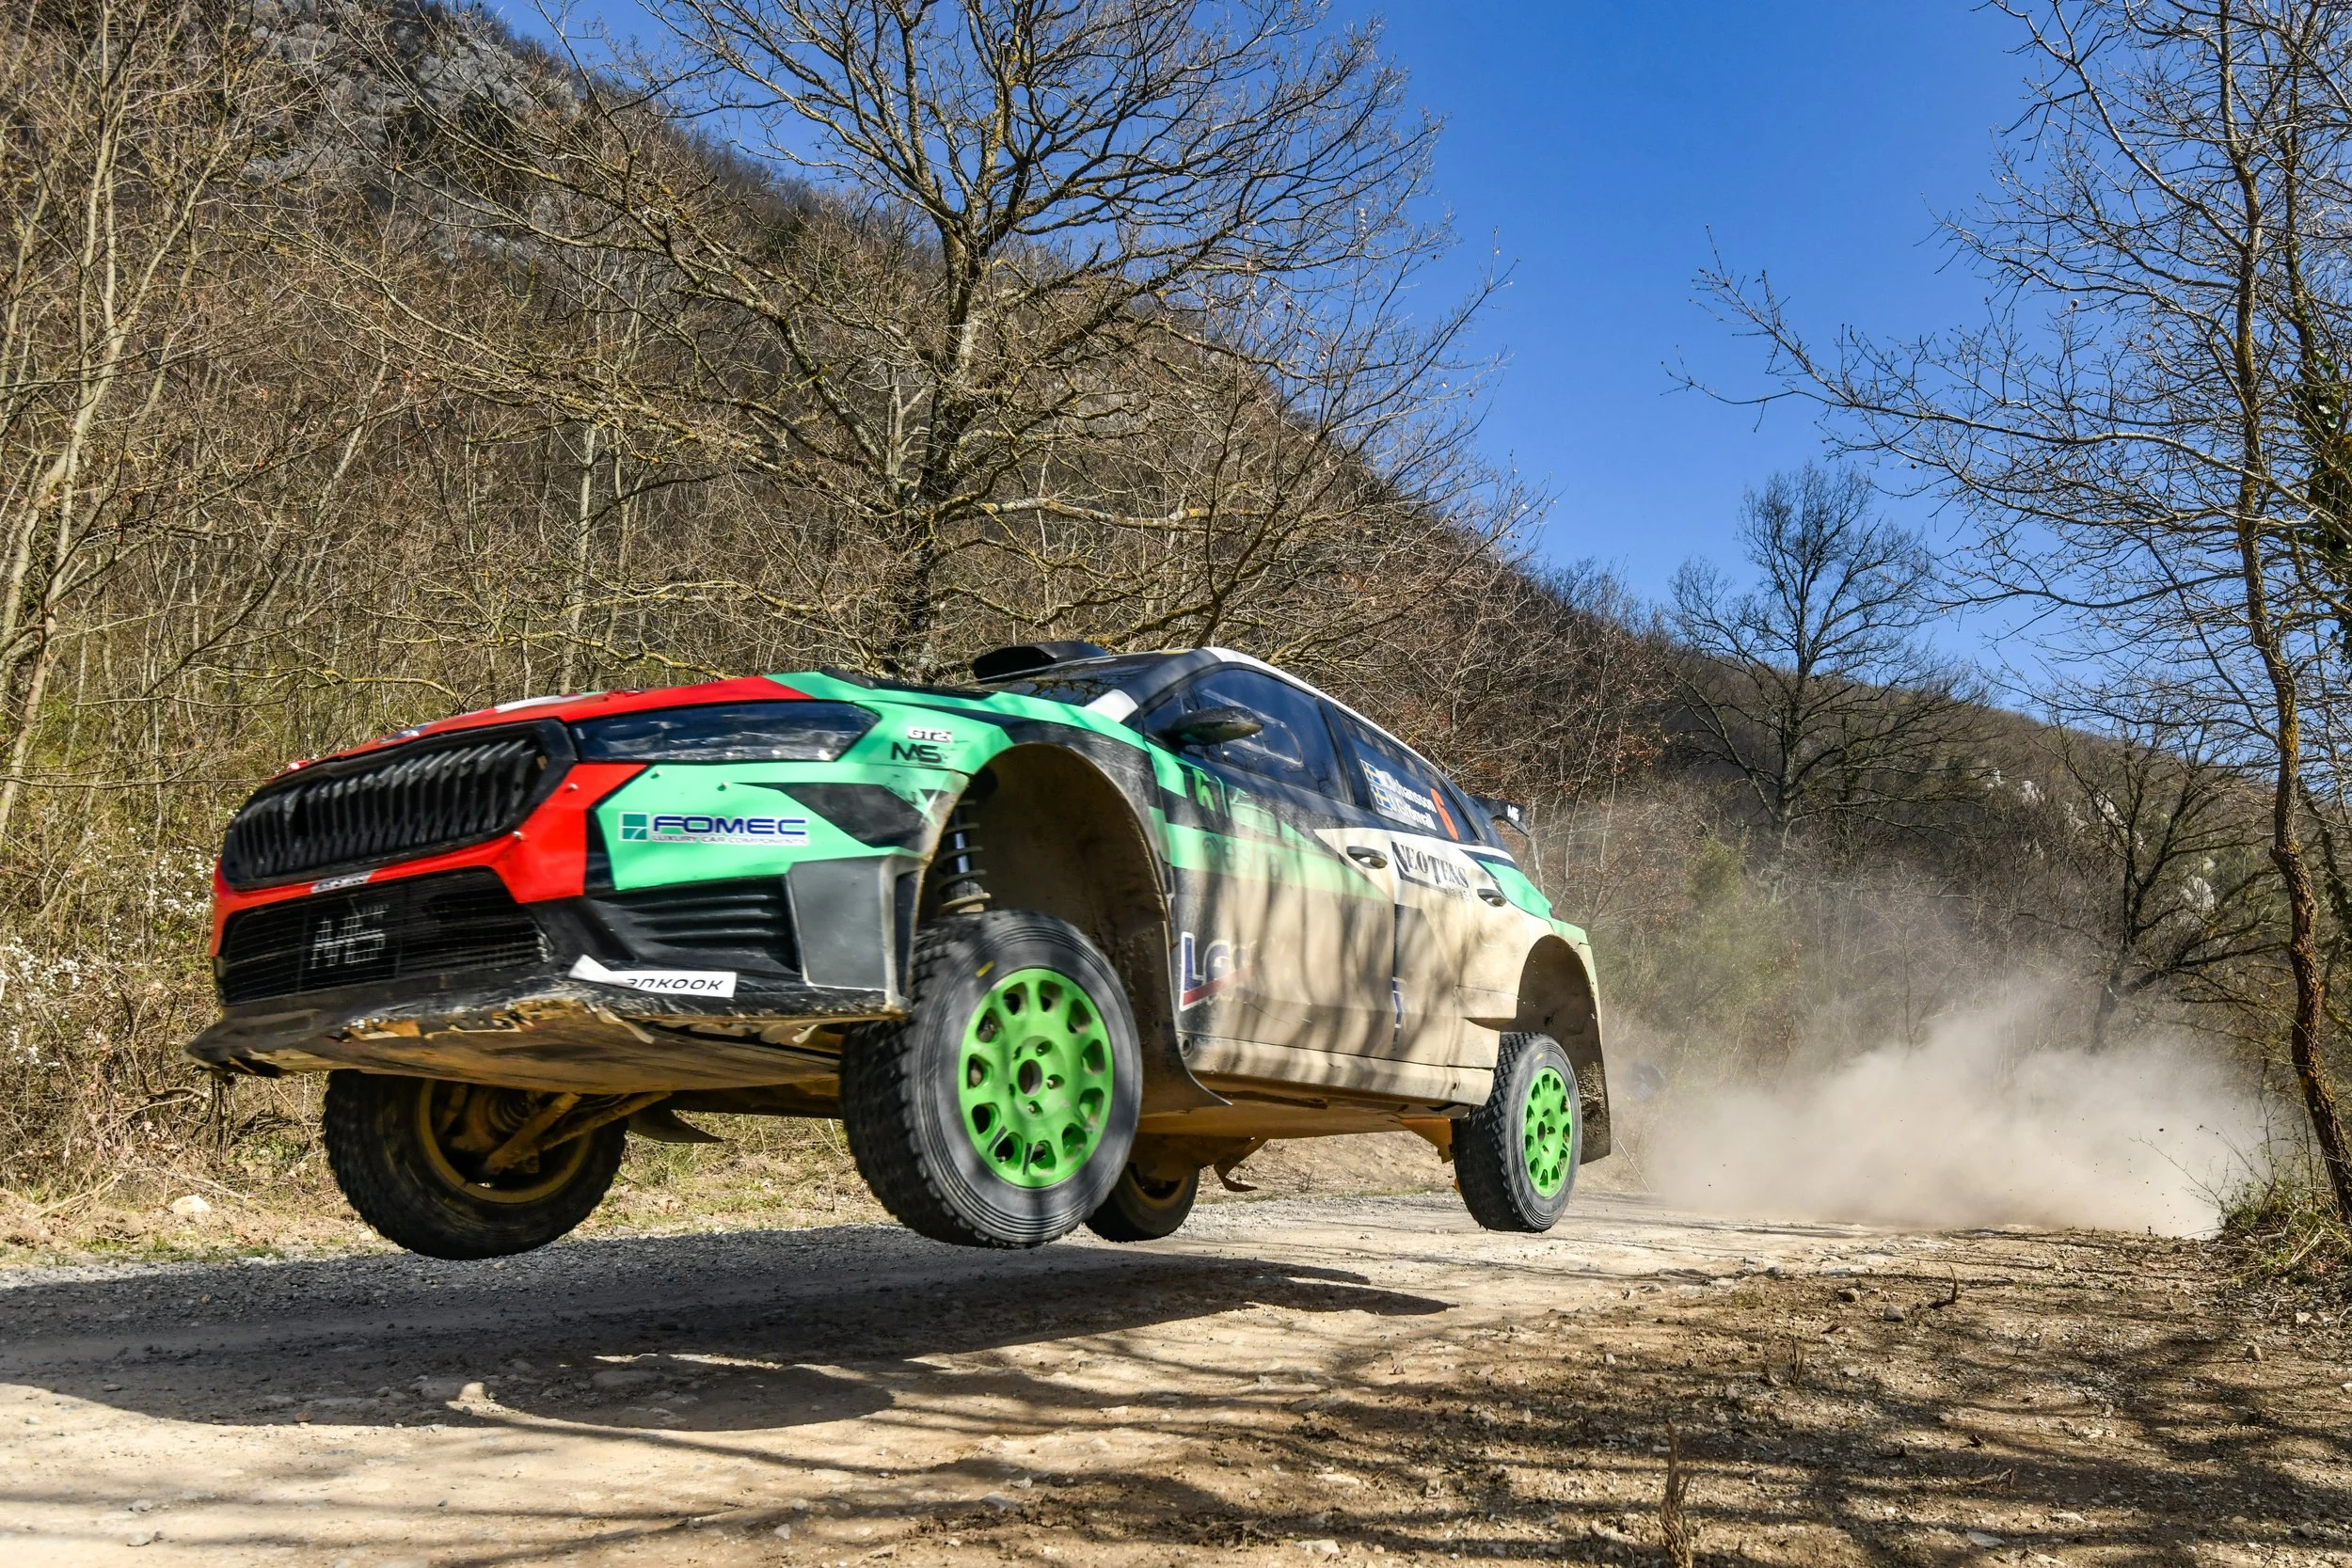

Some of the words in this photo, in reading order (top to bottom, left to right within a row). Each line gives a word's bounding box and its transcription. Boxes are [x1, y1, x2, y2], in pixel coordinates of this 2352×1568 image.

[890, 741, 943, 764] MS
[653, 816, 806, 835] FOMEC
[1430, 786, 1459, 841] 6
[1391, 841, 1470, 889] NEOTENS
